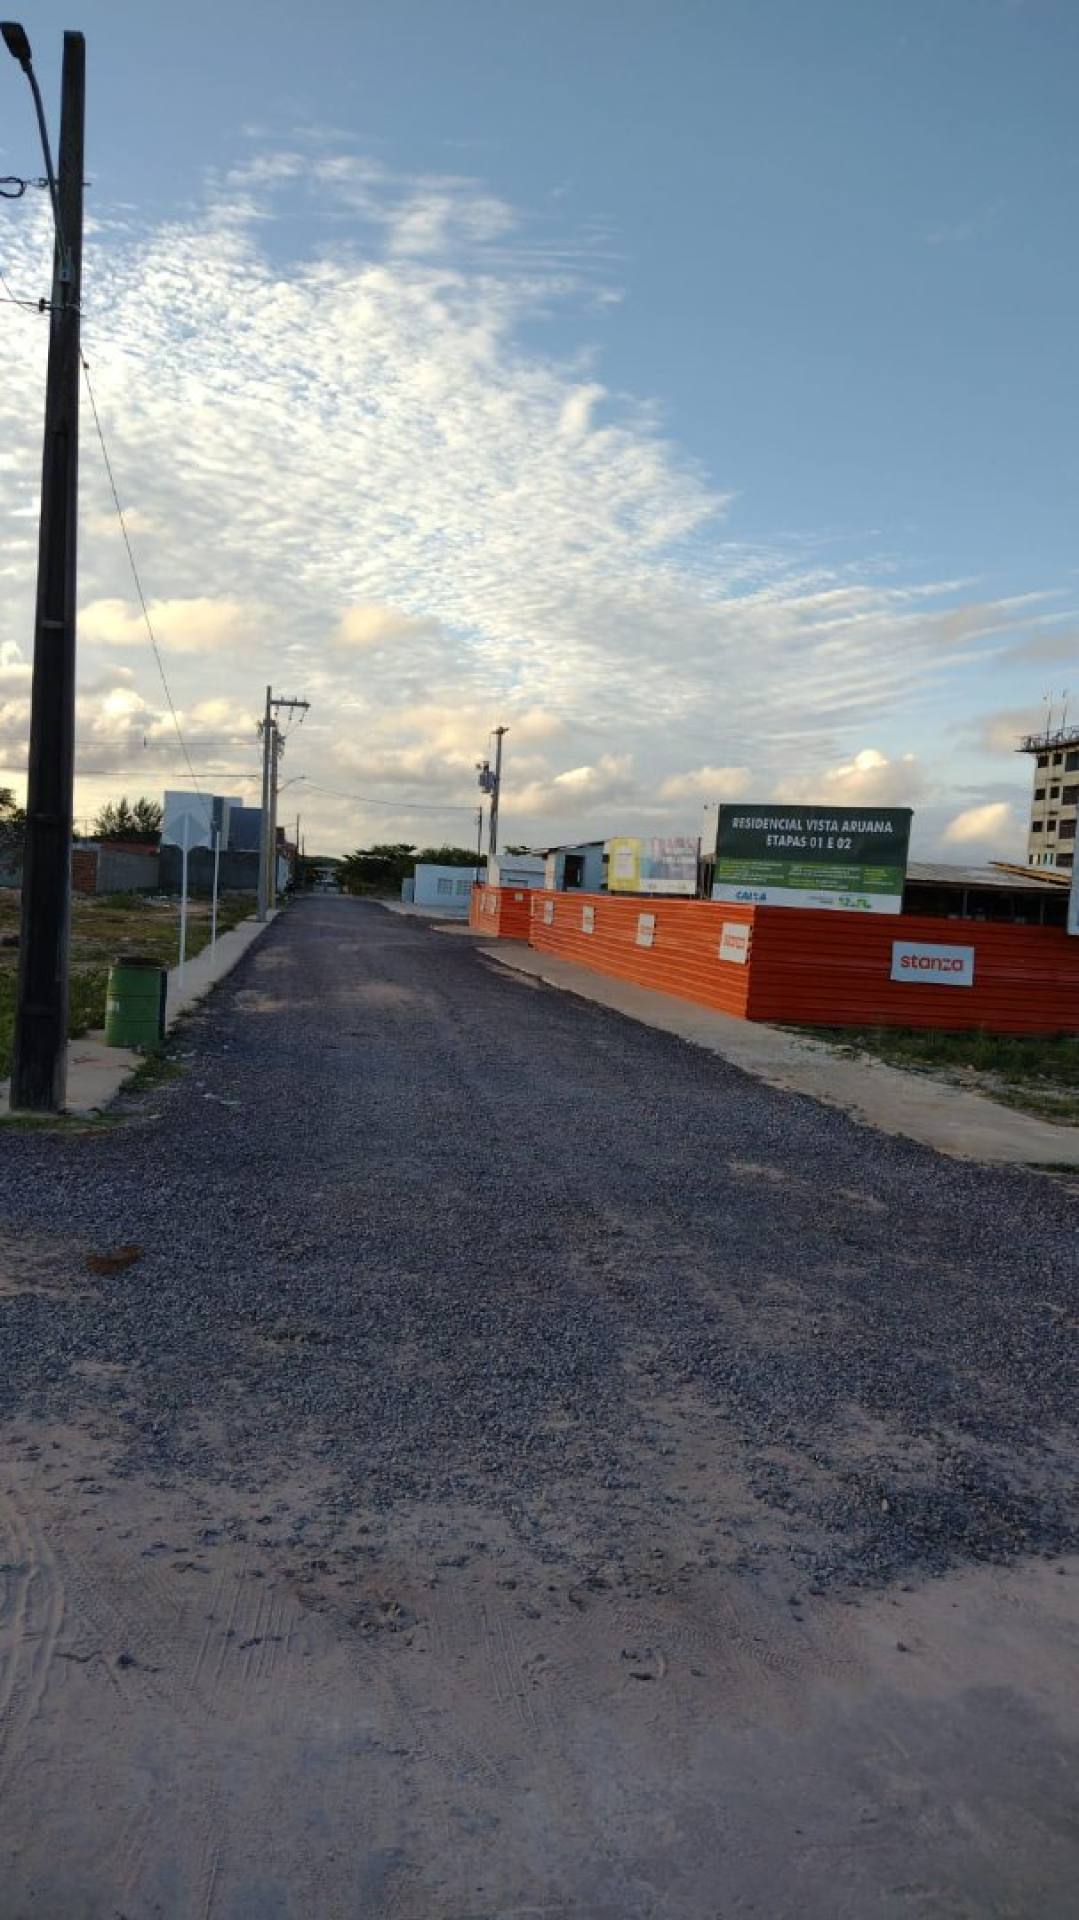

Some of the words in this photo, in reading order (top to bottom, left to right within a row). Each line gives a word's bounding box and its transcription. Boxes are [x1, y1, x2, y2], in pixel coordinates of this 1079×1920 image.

[732, 817, 803, 831] RESIDENCIAL
[806, 819, 839, 832] VISTA
[841, 820, 894, 833] ARUANA
[766, 834, 806, 847] ETAPAS
[810, 836, 823, 848] 01
[827, 837, 834, 848] E
[836, 837, 852, 849] 02
[900, 953, 964, 972] stanza
